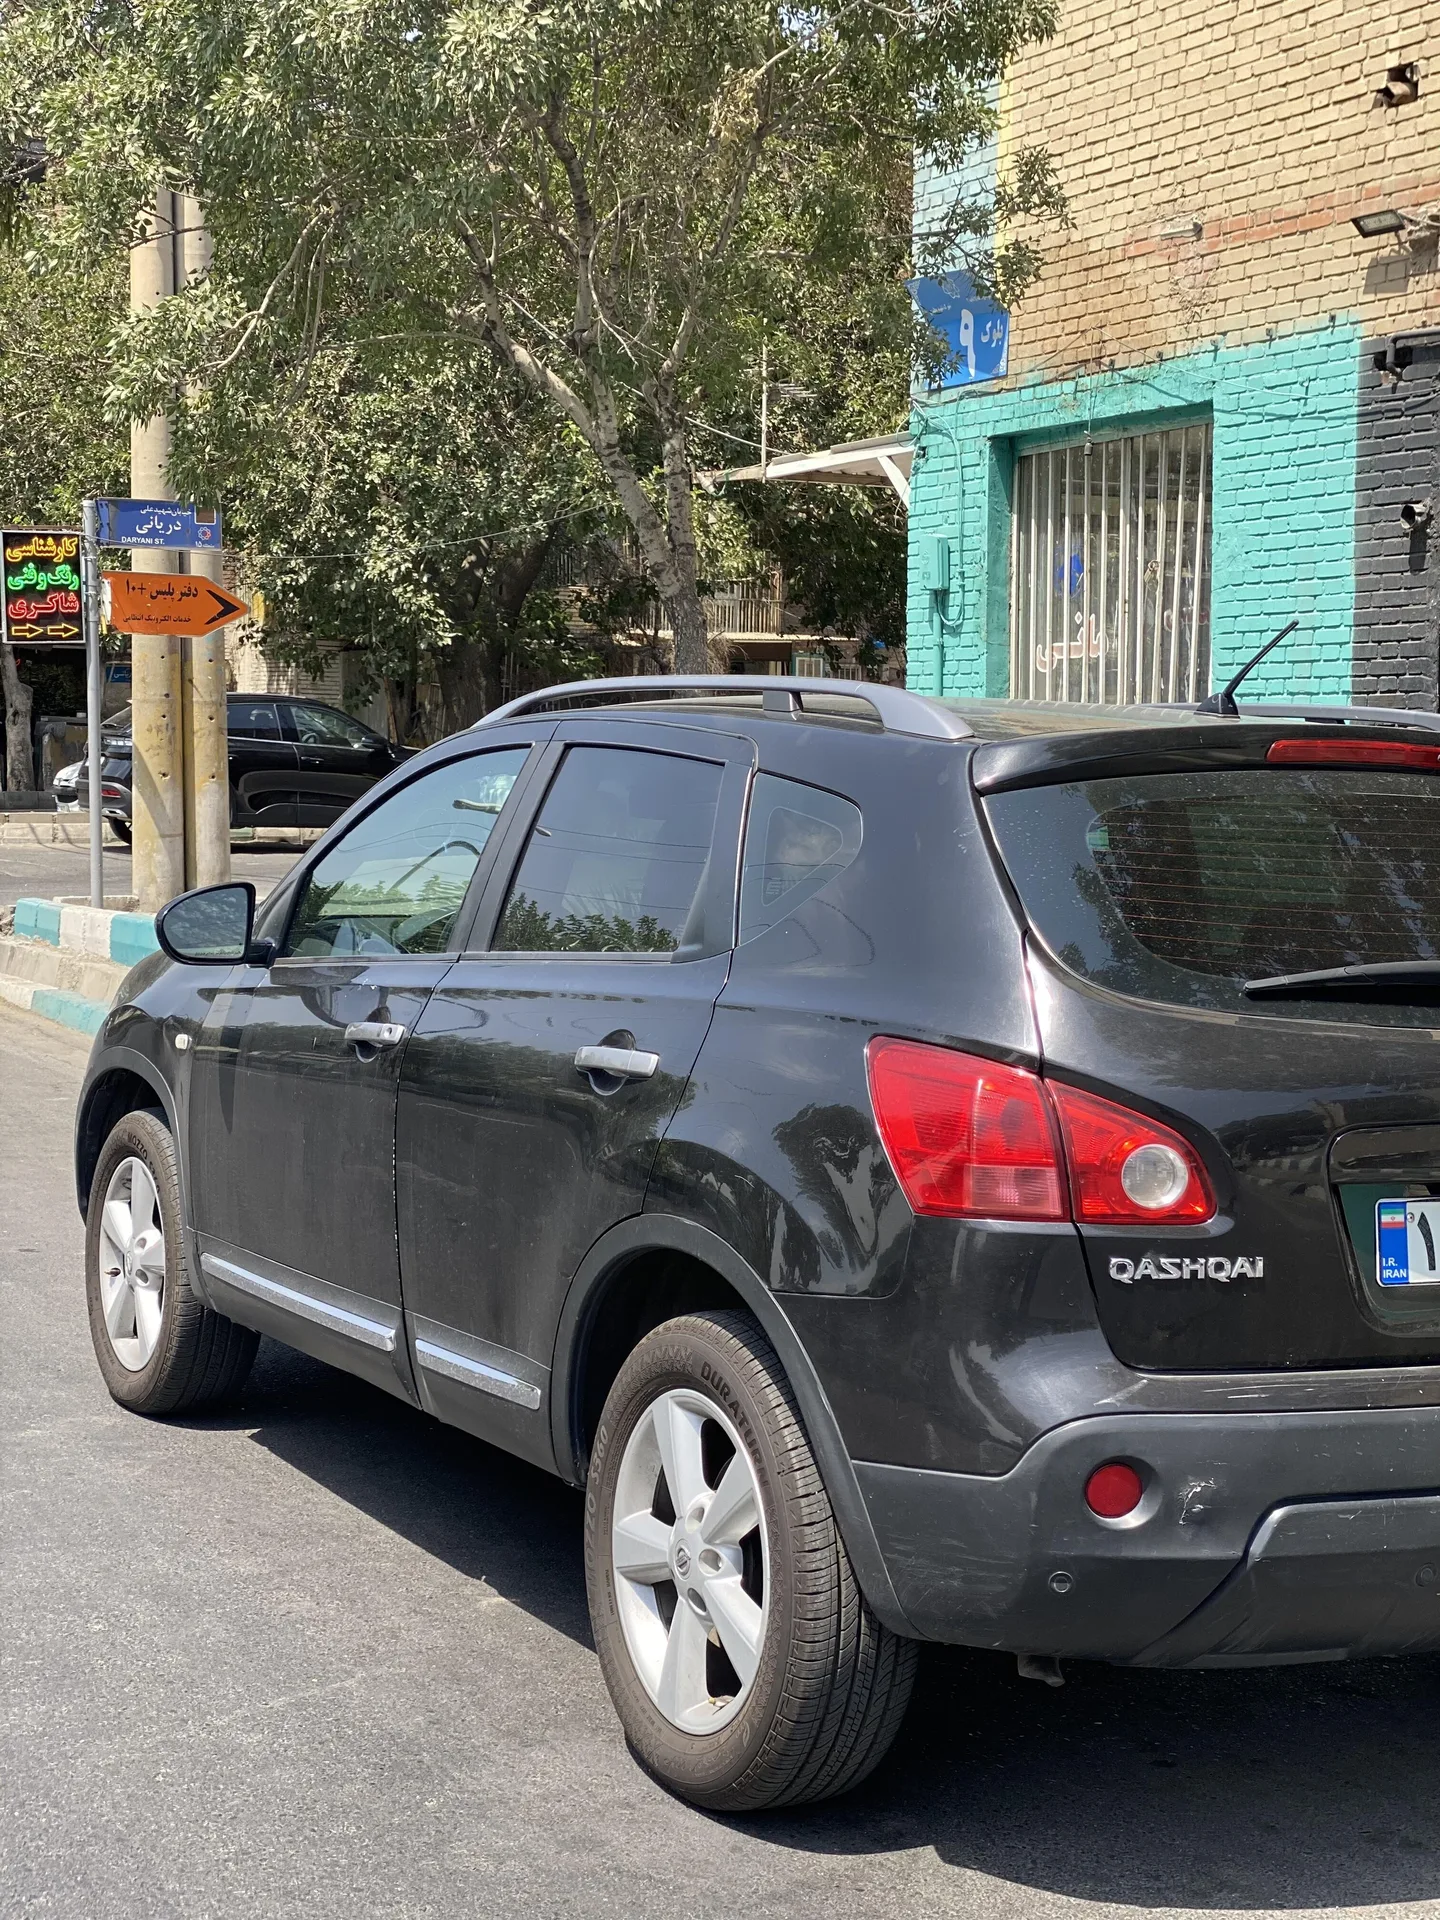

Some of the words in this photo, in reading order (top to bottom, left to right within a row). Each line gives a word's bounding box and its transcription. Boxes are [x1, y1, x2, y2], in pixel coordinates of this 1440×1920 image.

[960, 308, 976, 378] ۹
[981, 318, 1004, 348] بلوک
[140, 504, 154, 515] علی
[135, 515, 182, 534] دریانی
[6, 536, 78, 562] کارشناسی
[121, 536, 153, 545] DARYANI
[7, 562, 38, 590] فنی
[36, 572, 47, 590] و
[47, 564, 80, 590] رنگ
[149, 582, 175, 602] پلیس
[177, 582, 199, 602] دفتر
[8, 592, 80, 619] شاکری
[172, 614, 192, 623] خدمات
[1108, 1256, 1265, 1284] QASHQAI
[1382, 1257, 1398, 1267] I.R.
[1382, 1268, 1407, 1279] IRAN
